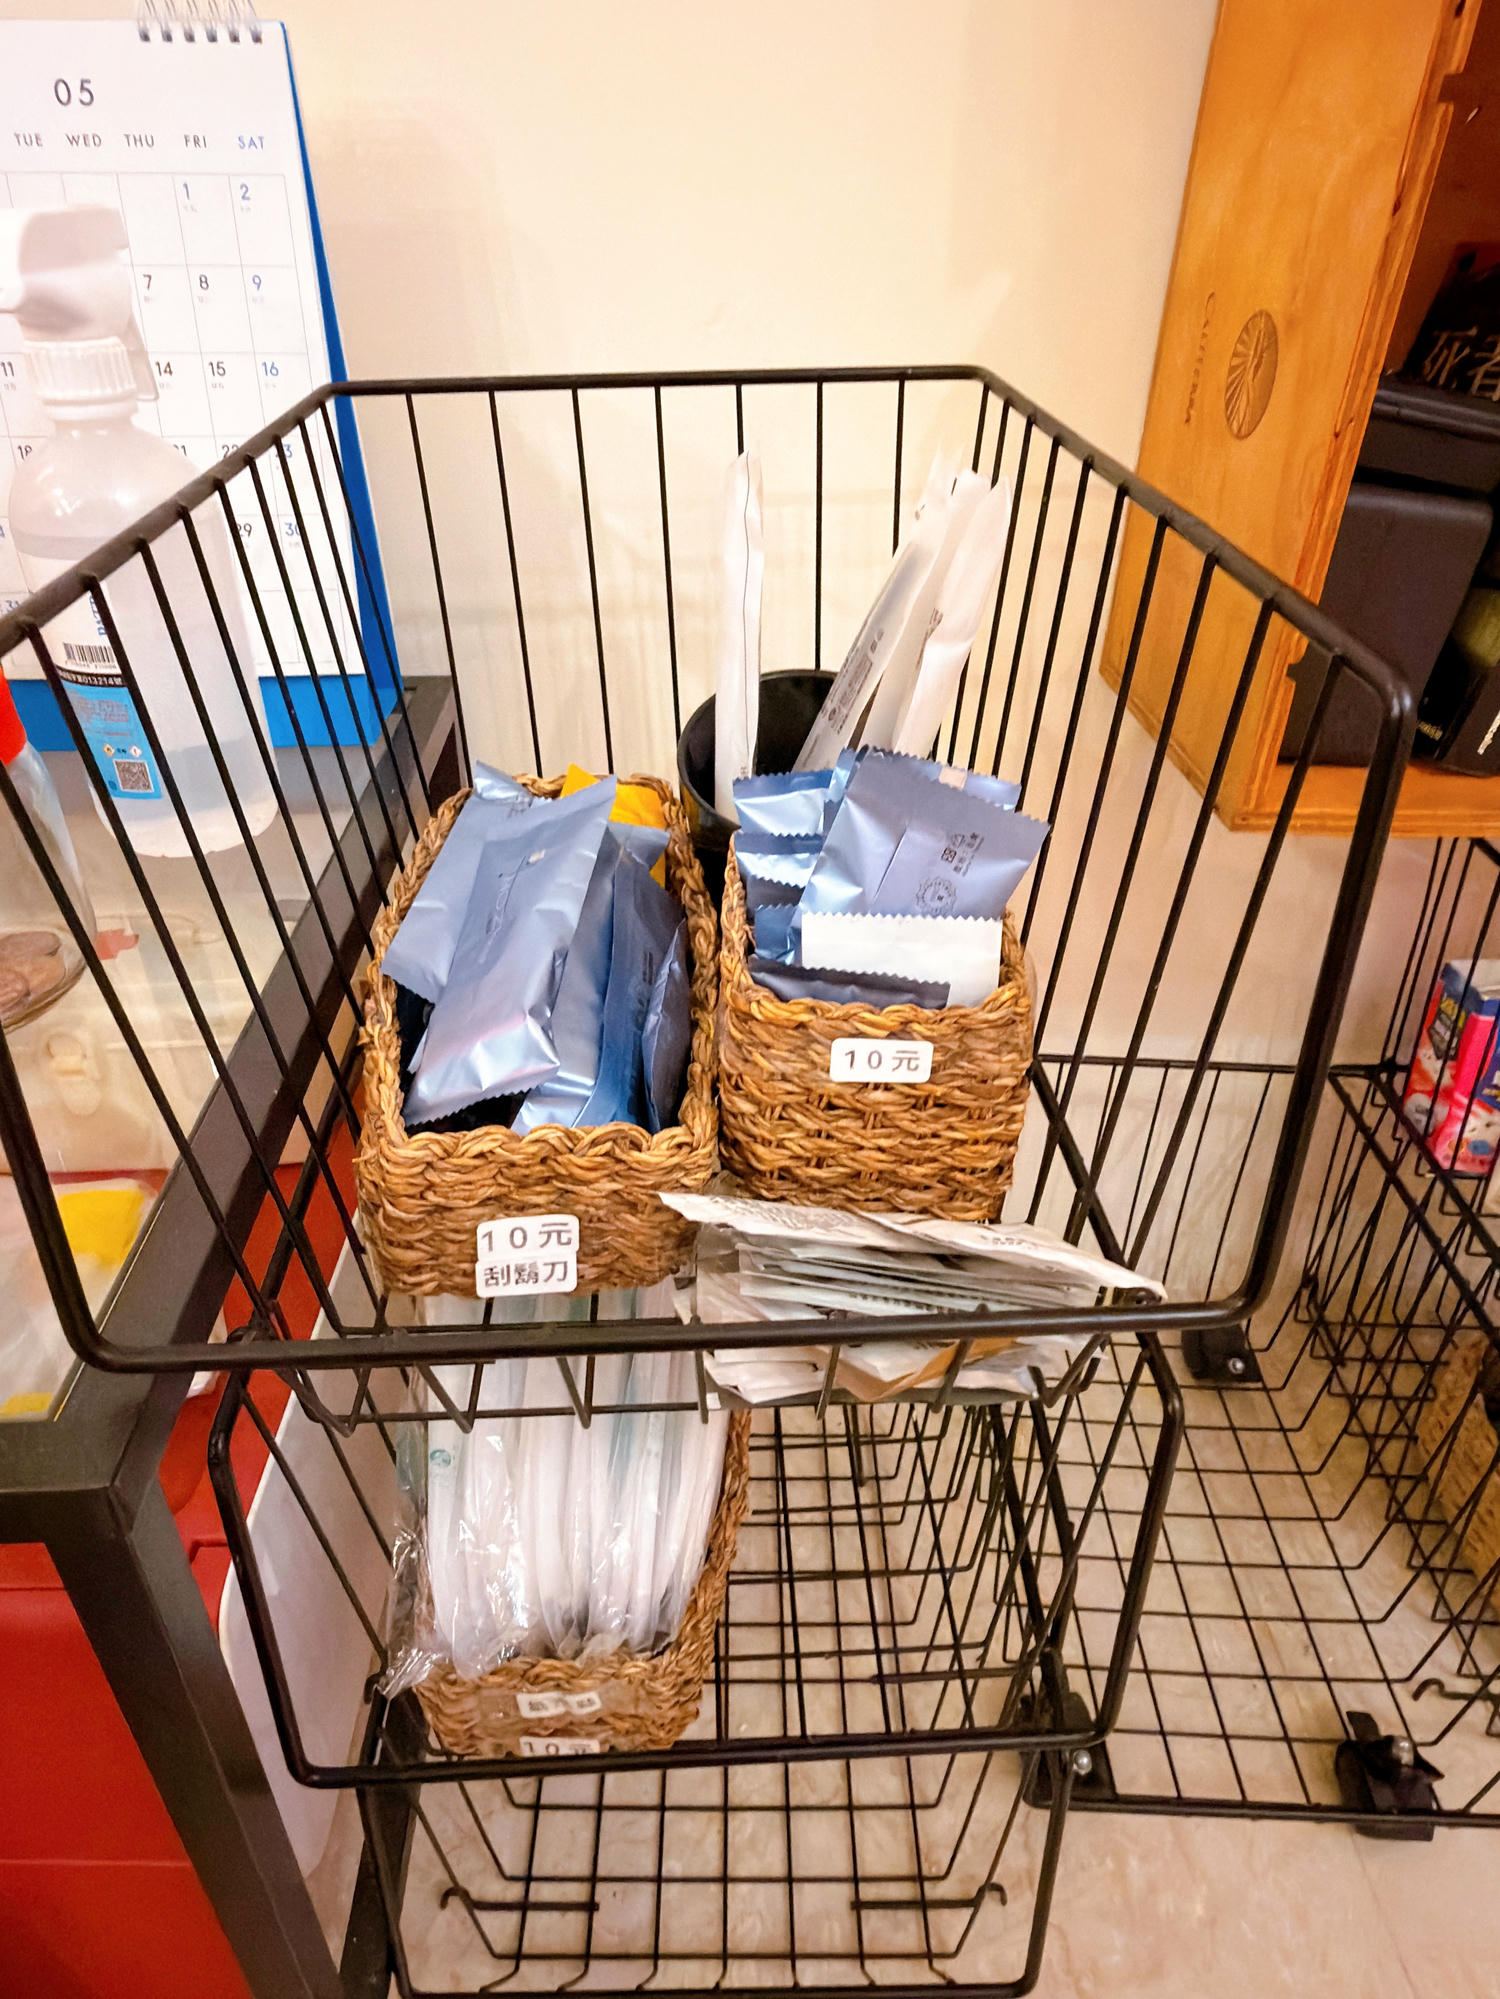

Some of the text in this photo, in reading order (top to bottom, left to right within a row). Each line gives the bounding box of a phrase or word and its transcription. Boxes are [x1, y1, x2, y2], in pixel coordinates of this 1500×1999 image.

[54, 77, 95, 107] 05
[13, 132, 264, 149] TUE WED THU FRI SAT
[182, 182, 251, 201] 1 2
[142, 273, 262, 291] 7 8 9
[1, 360, 279, 377] 11 14 15 16
[844, 1049, 921, 1073] 10元
[481, 1222, 573, 1253] 10元
[483, 1259, 569, 1289] 刮鬍刀
